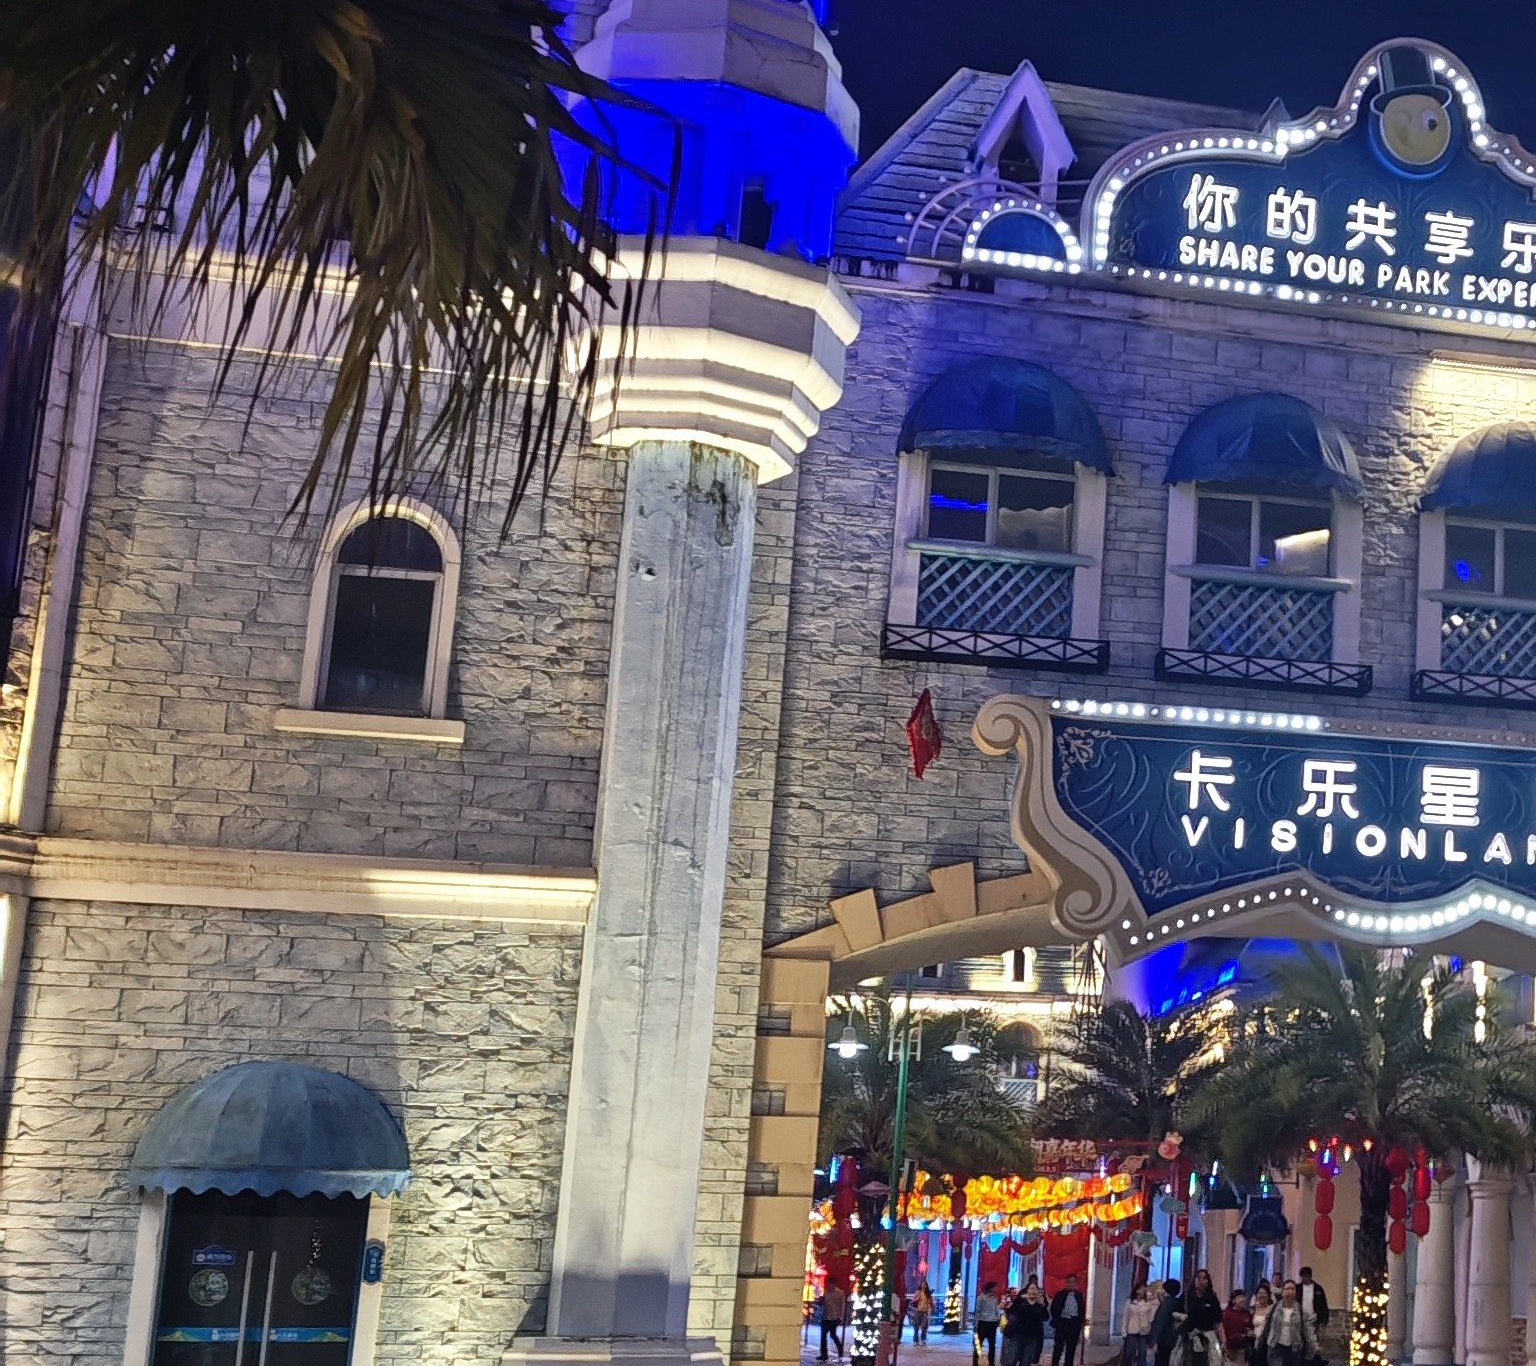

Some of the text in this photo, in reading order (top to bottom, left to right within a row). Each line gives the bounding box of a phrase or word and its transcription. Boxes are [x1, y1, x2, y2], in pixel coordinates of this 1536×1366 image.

[1178, 235, 1275, 276] SHARE
[1285, 249, 1366, 288] YOUR
[1376, 262, 1450, 296] PARK
